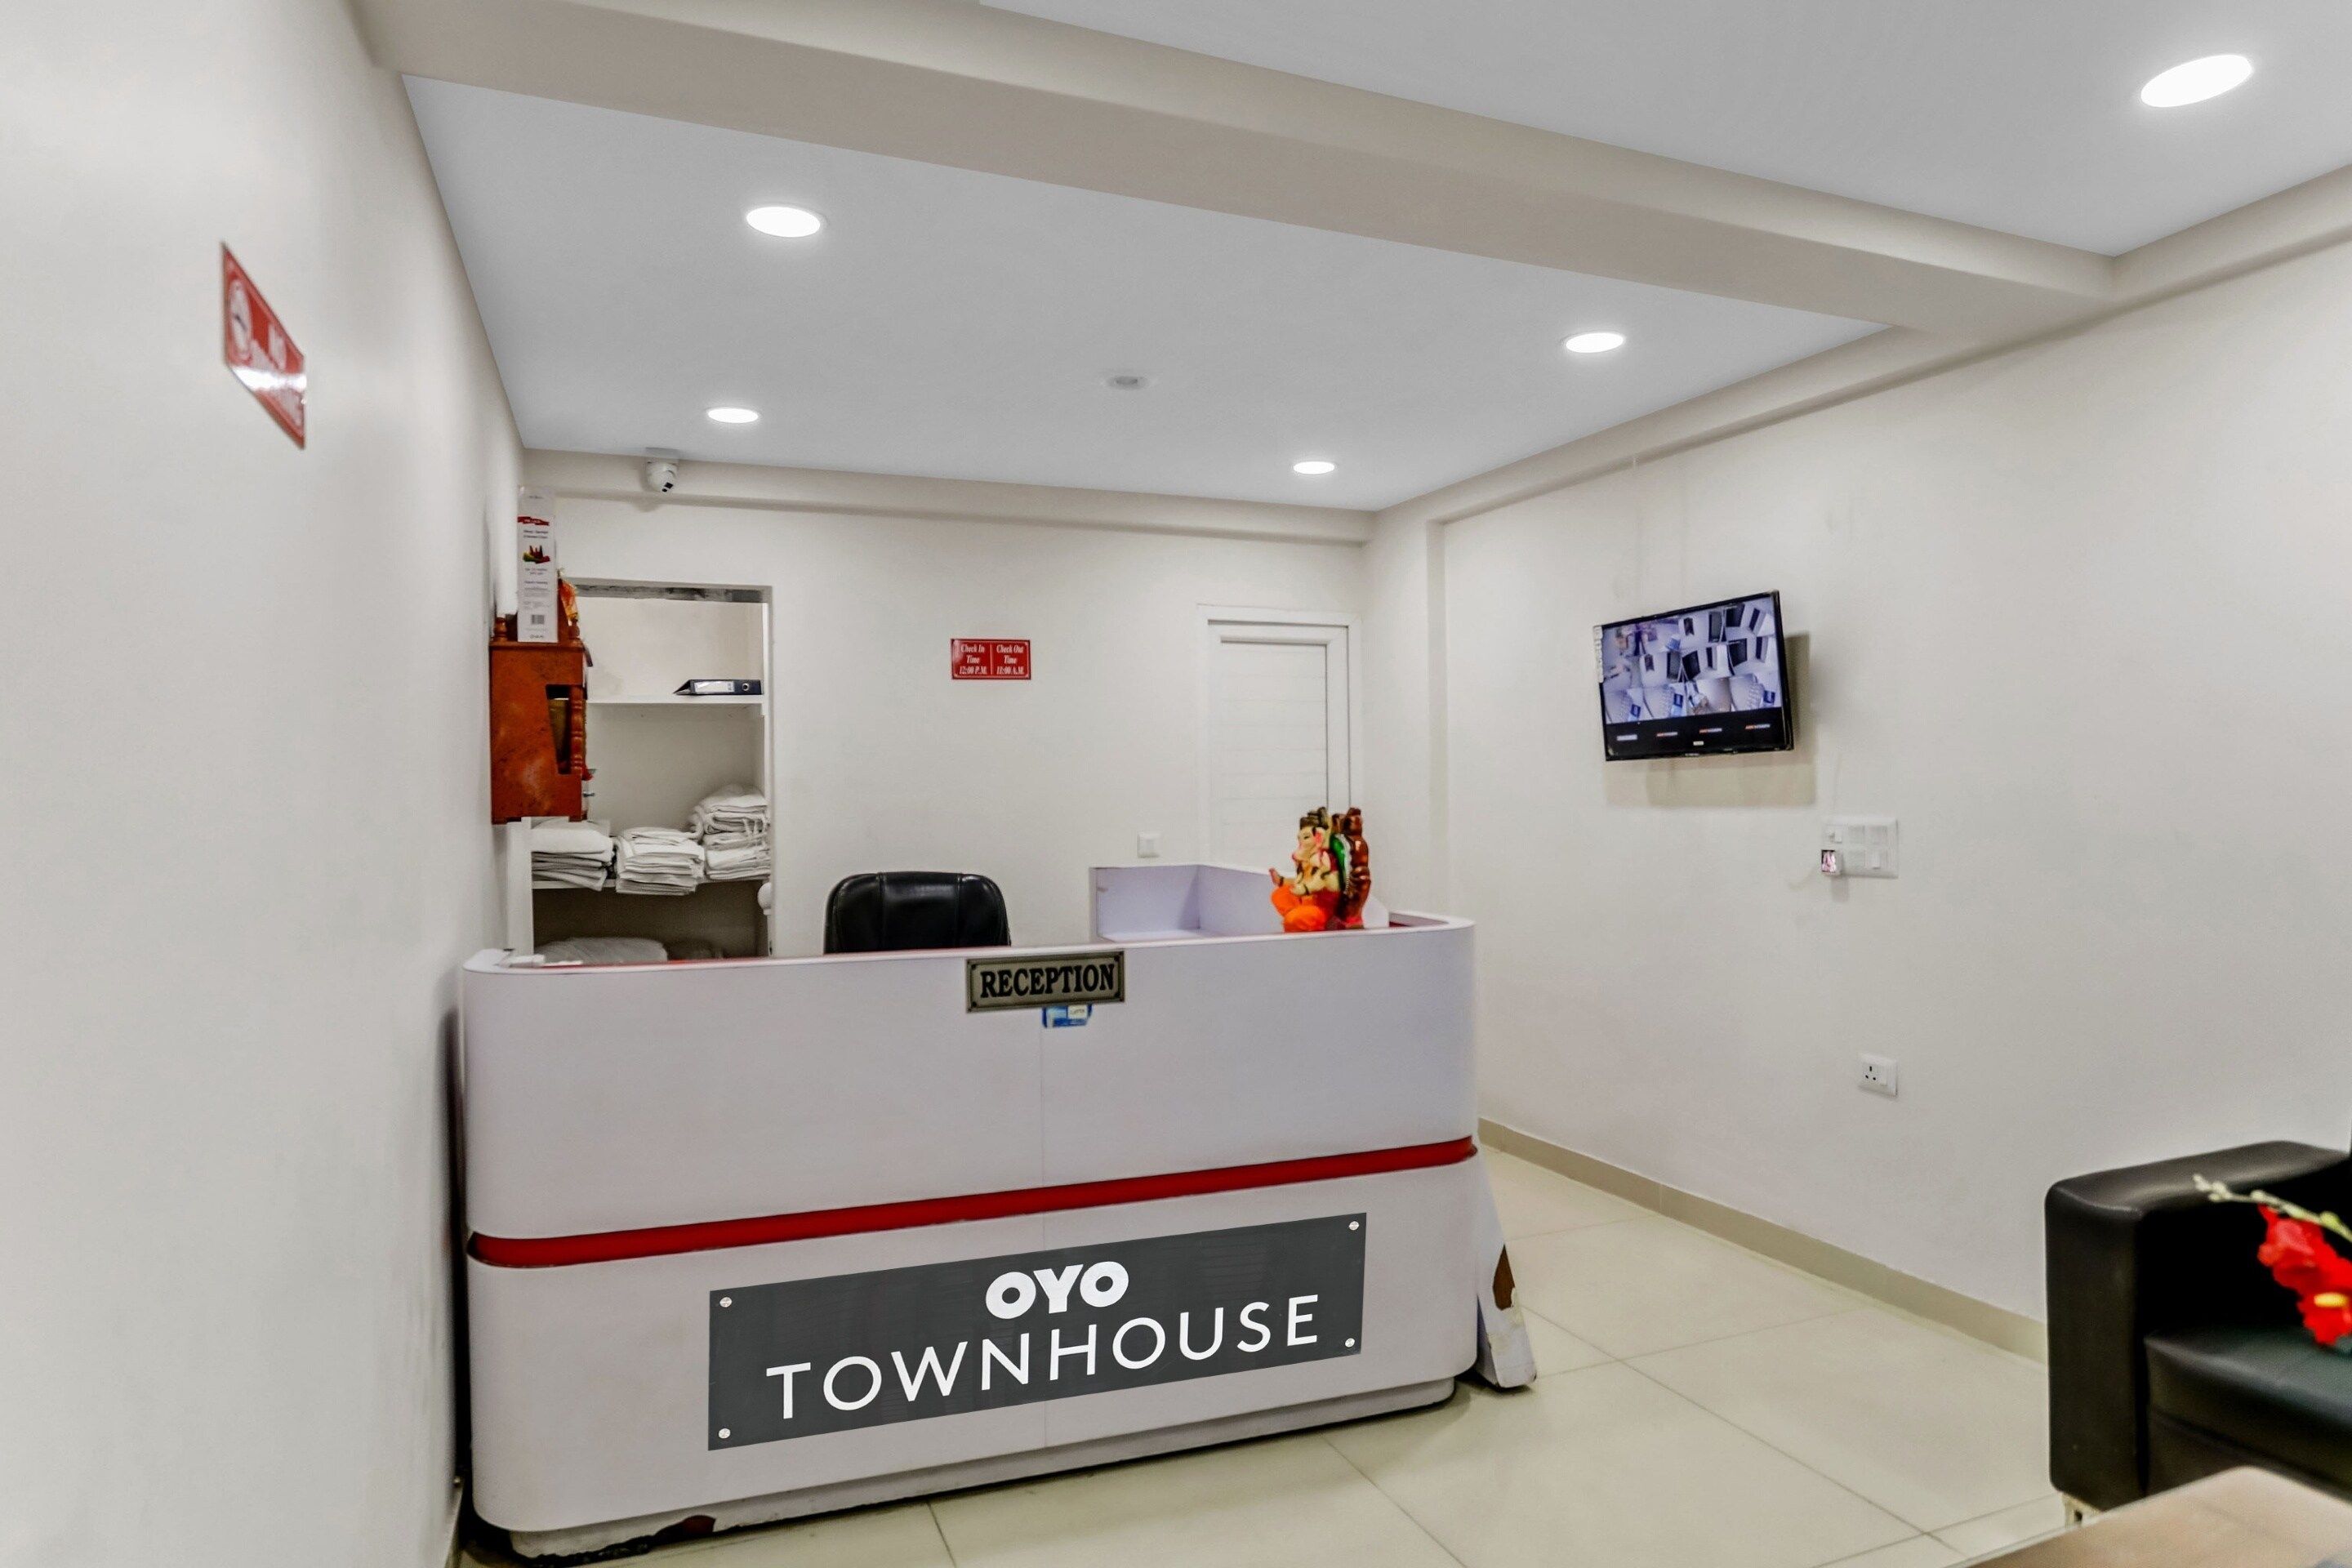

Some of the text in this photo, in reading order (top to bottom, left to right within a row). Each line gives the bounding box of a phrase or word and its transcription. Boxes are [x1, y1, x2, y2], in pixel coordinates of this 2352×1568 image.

[961, 644, 985, 653] Check In
[996, 644, 1023, 653] Check Out
[966, 654, 980, 663] Time
[1004, 655, 1018, 664] Time
[980, 964, 1115, 998] RECEPTION
[986, 1262, 1129, 1319] OYO
[767, 1294, 1317, 1419] TOWNHOUSE
